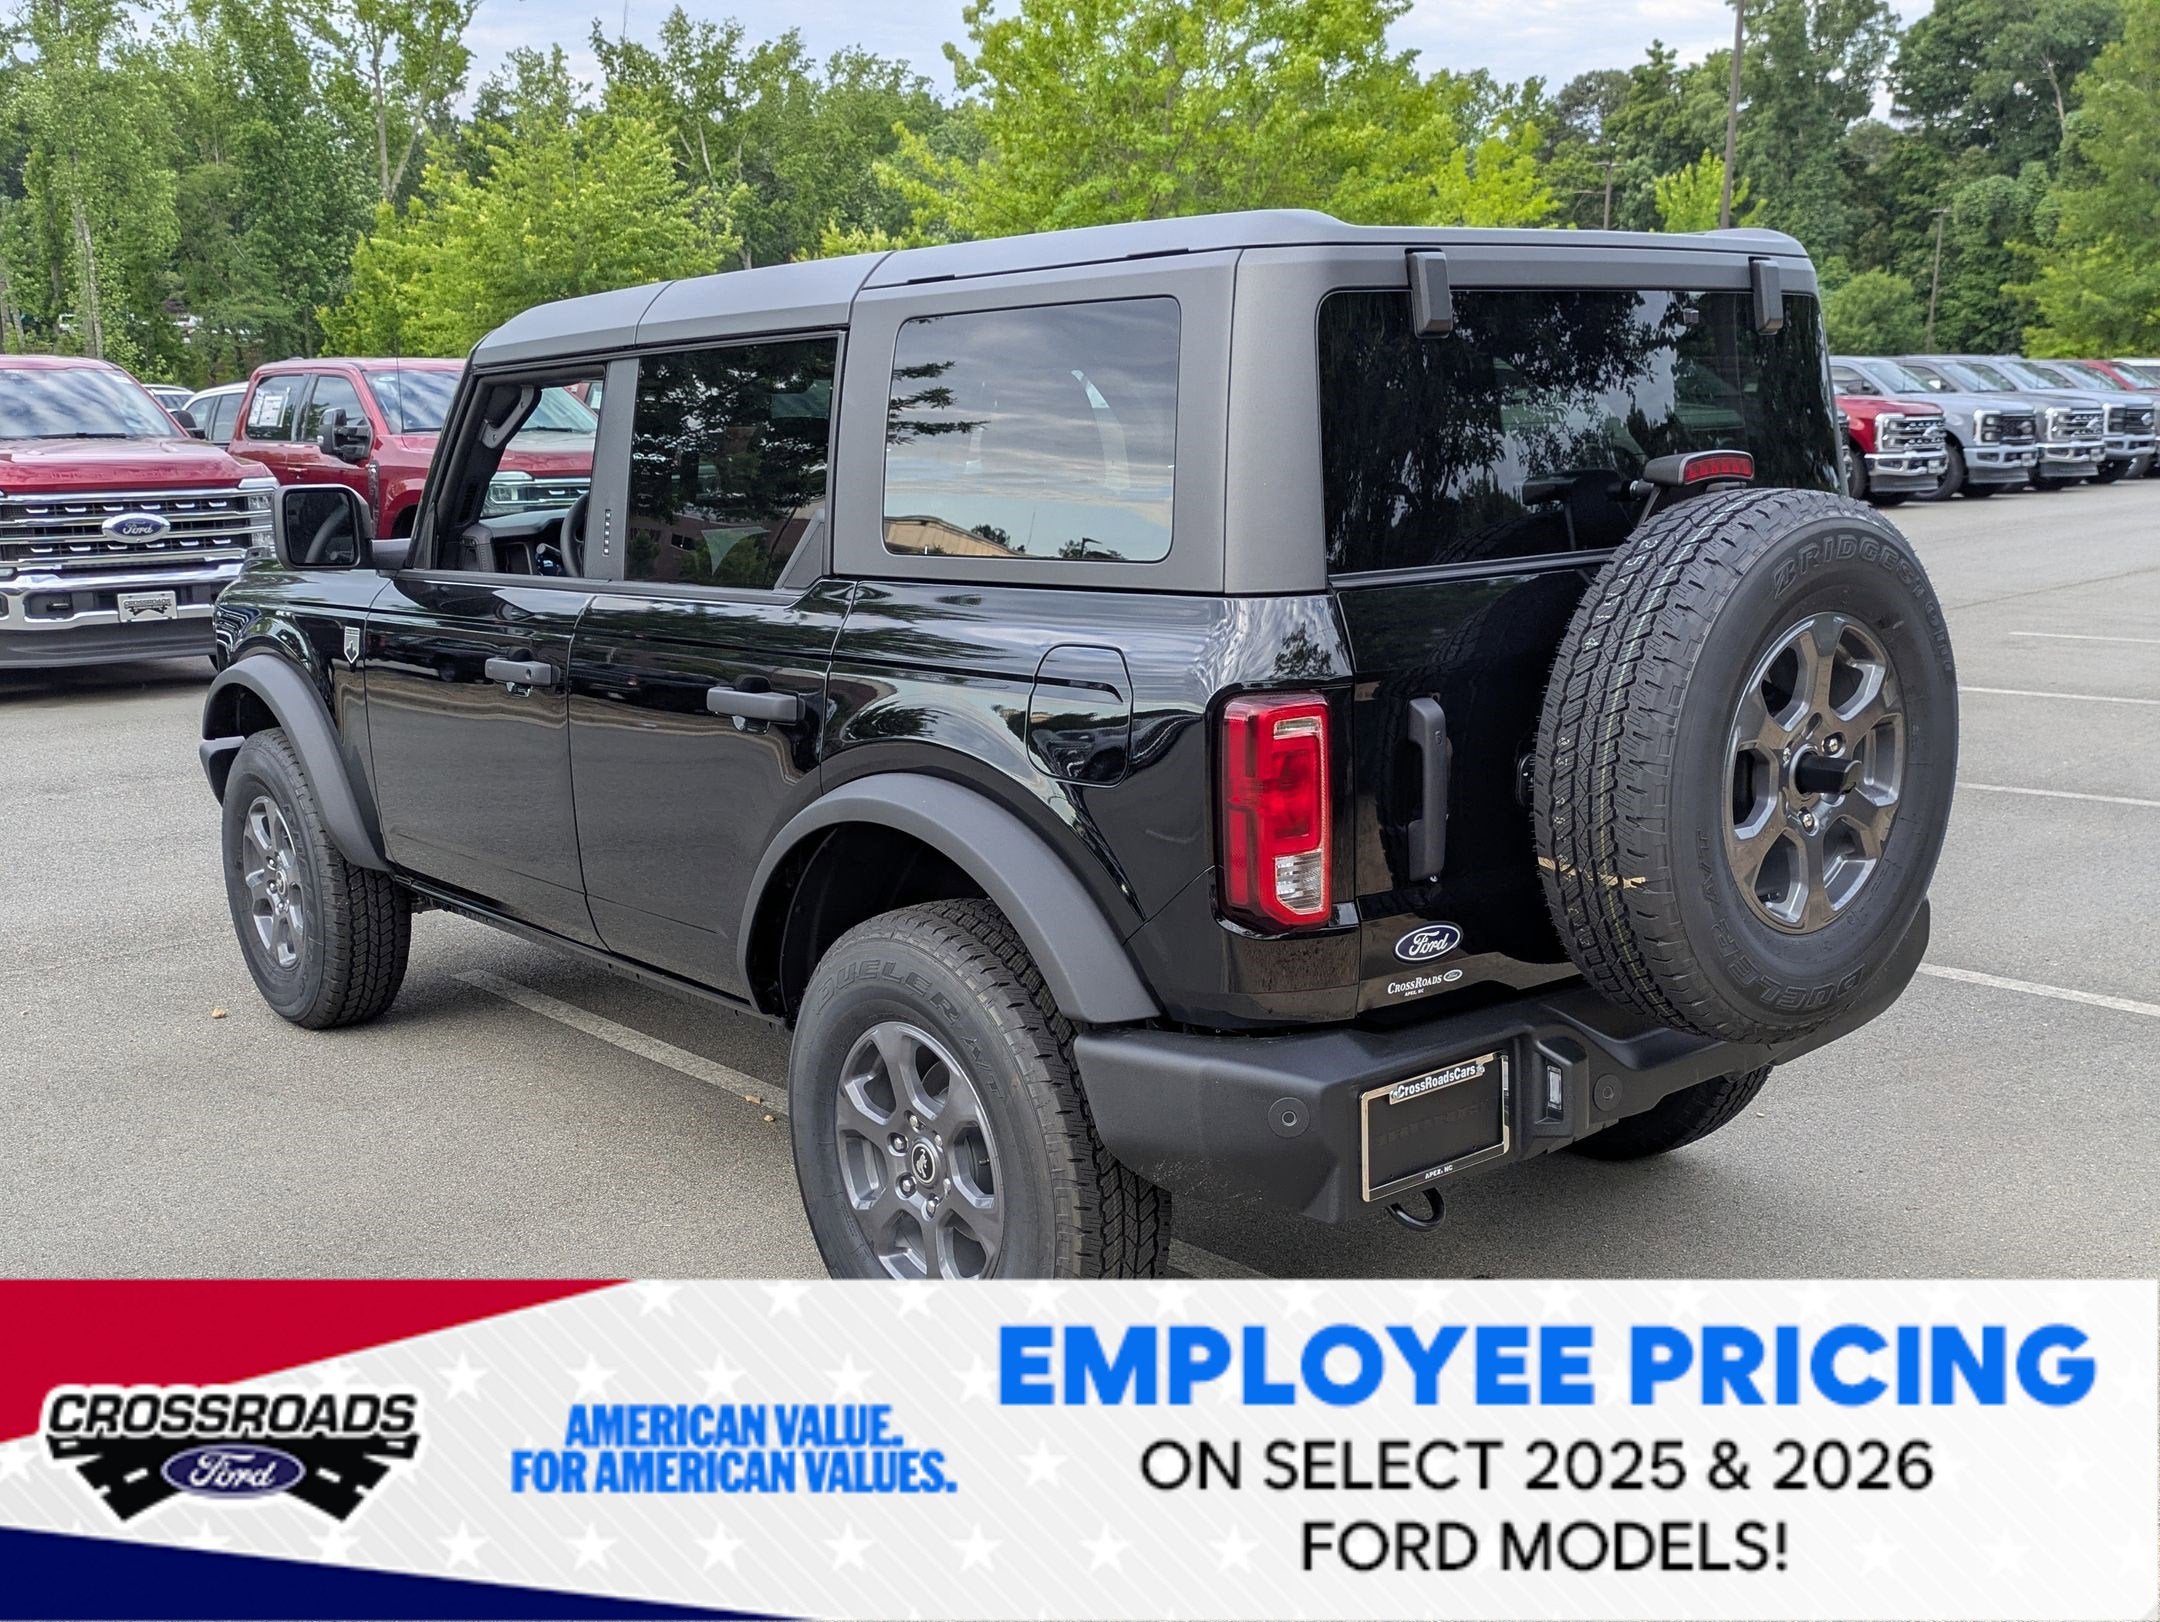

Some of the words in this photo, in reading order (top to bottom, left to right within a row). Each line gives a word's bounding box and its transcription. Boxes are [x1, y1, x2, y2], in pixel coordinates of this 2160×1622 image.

[122, 520, 154, 535] Ford
[1772, 533, 1954, 673] BRIDGESTONE
[1408, 930, 1450, 956] Ford
[1711, 918, 1866, 1010] DUELER
[815, 958, 961, 1026] DUELER
[1444, 1164, 1454, 1173] NC
